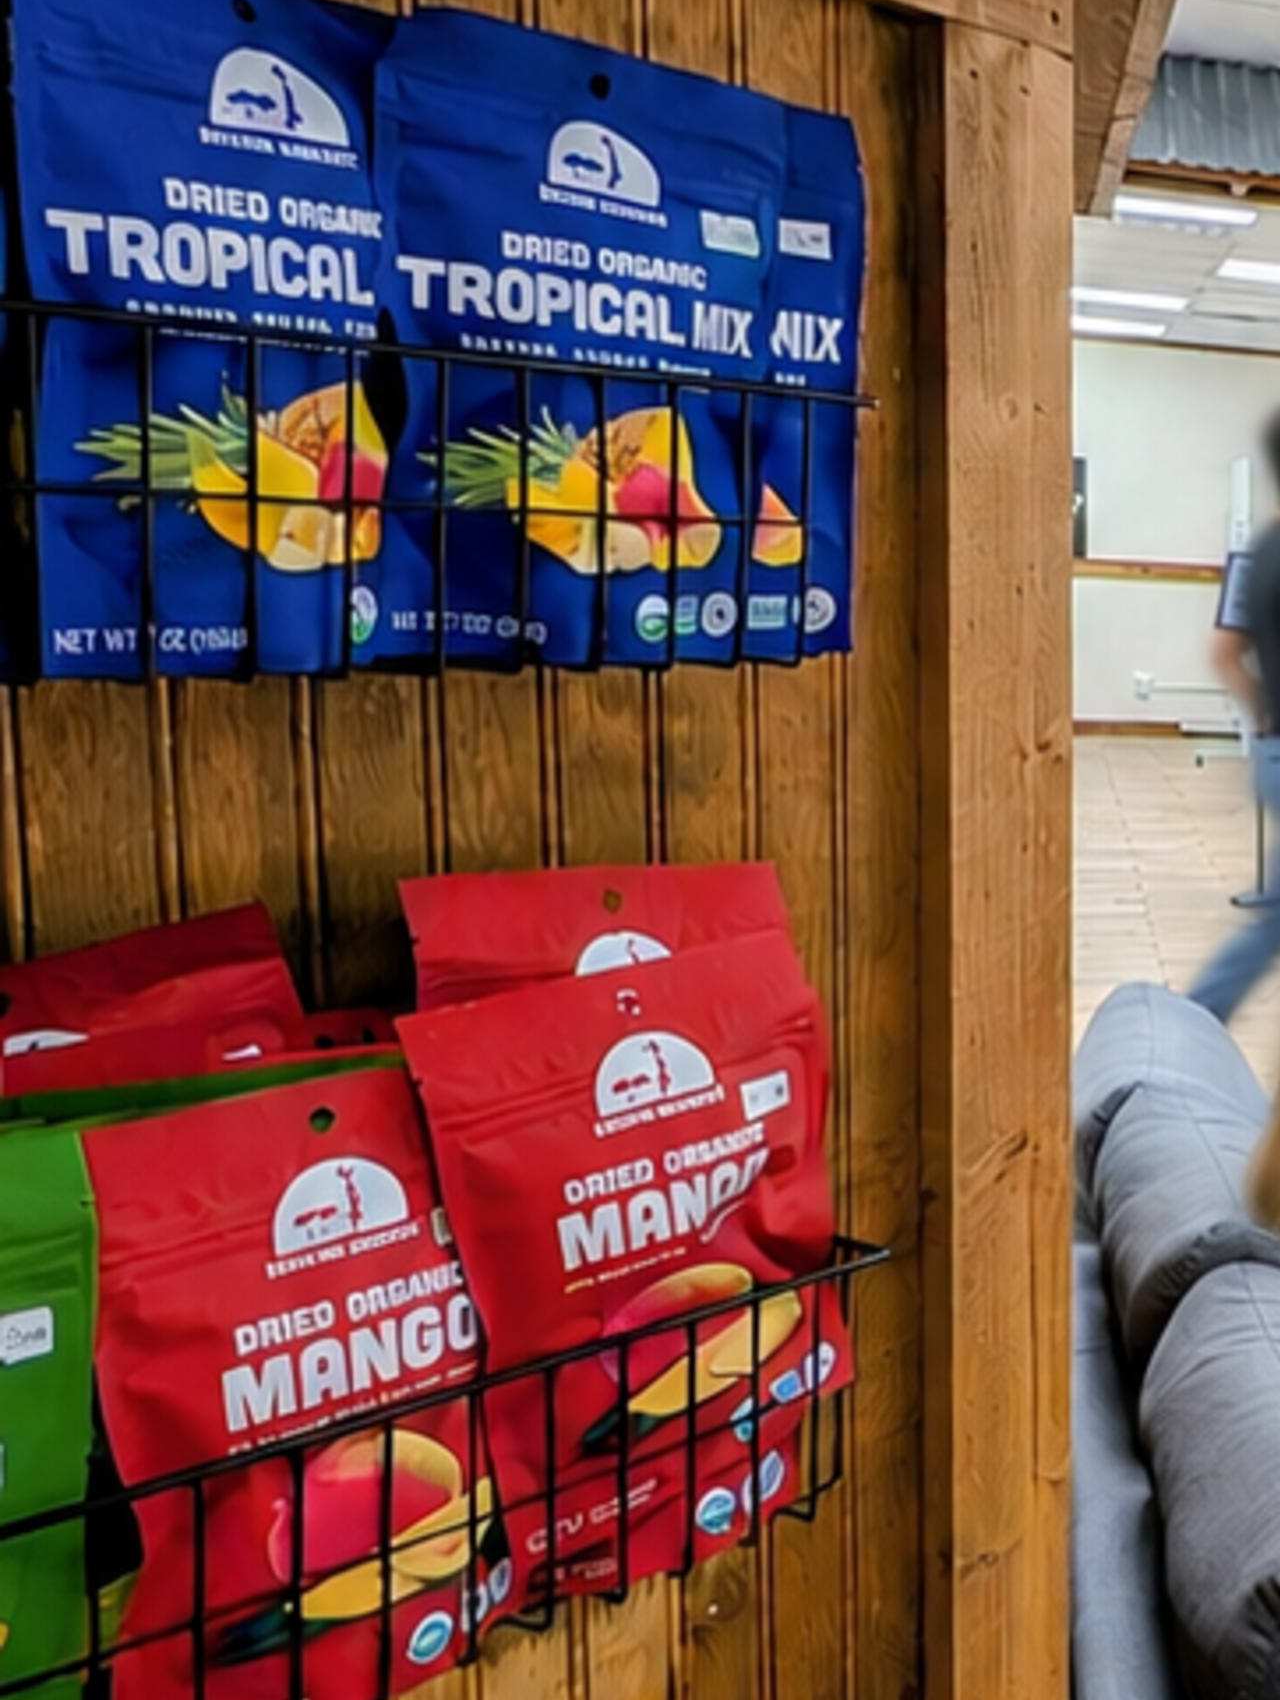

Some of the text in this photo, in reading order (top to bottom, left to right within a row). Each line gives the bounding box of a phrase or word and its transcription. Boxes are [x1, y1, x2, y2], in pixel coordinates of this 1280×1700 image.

[164, 176, 270, 222] DRIED
[45, 208, 375, 307] TROPICAL
[502, 230, 592, 270] DRIED
[396, 255, 686, 347] TROPICAL
[692, 301, 754, 360] MIX
[221, 1292, 478, 1435] MANGO
[234, 1300, 336, 1357] DRIED
